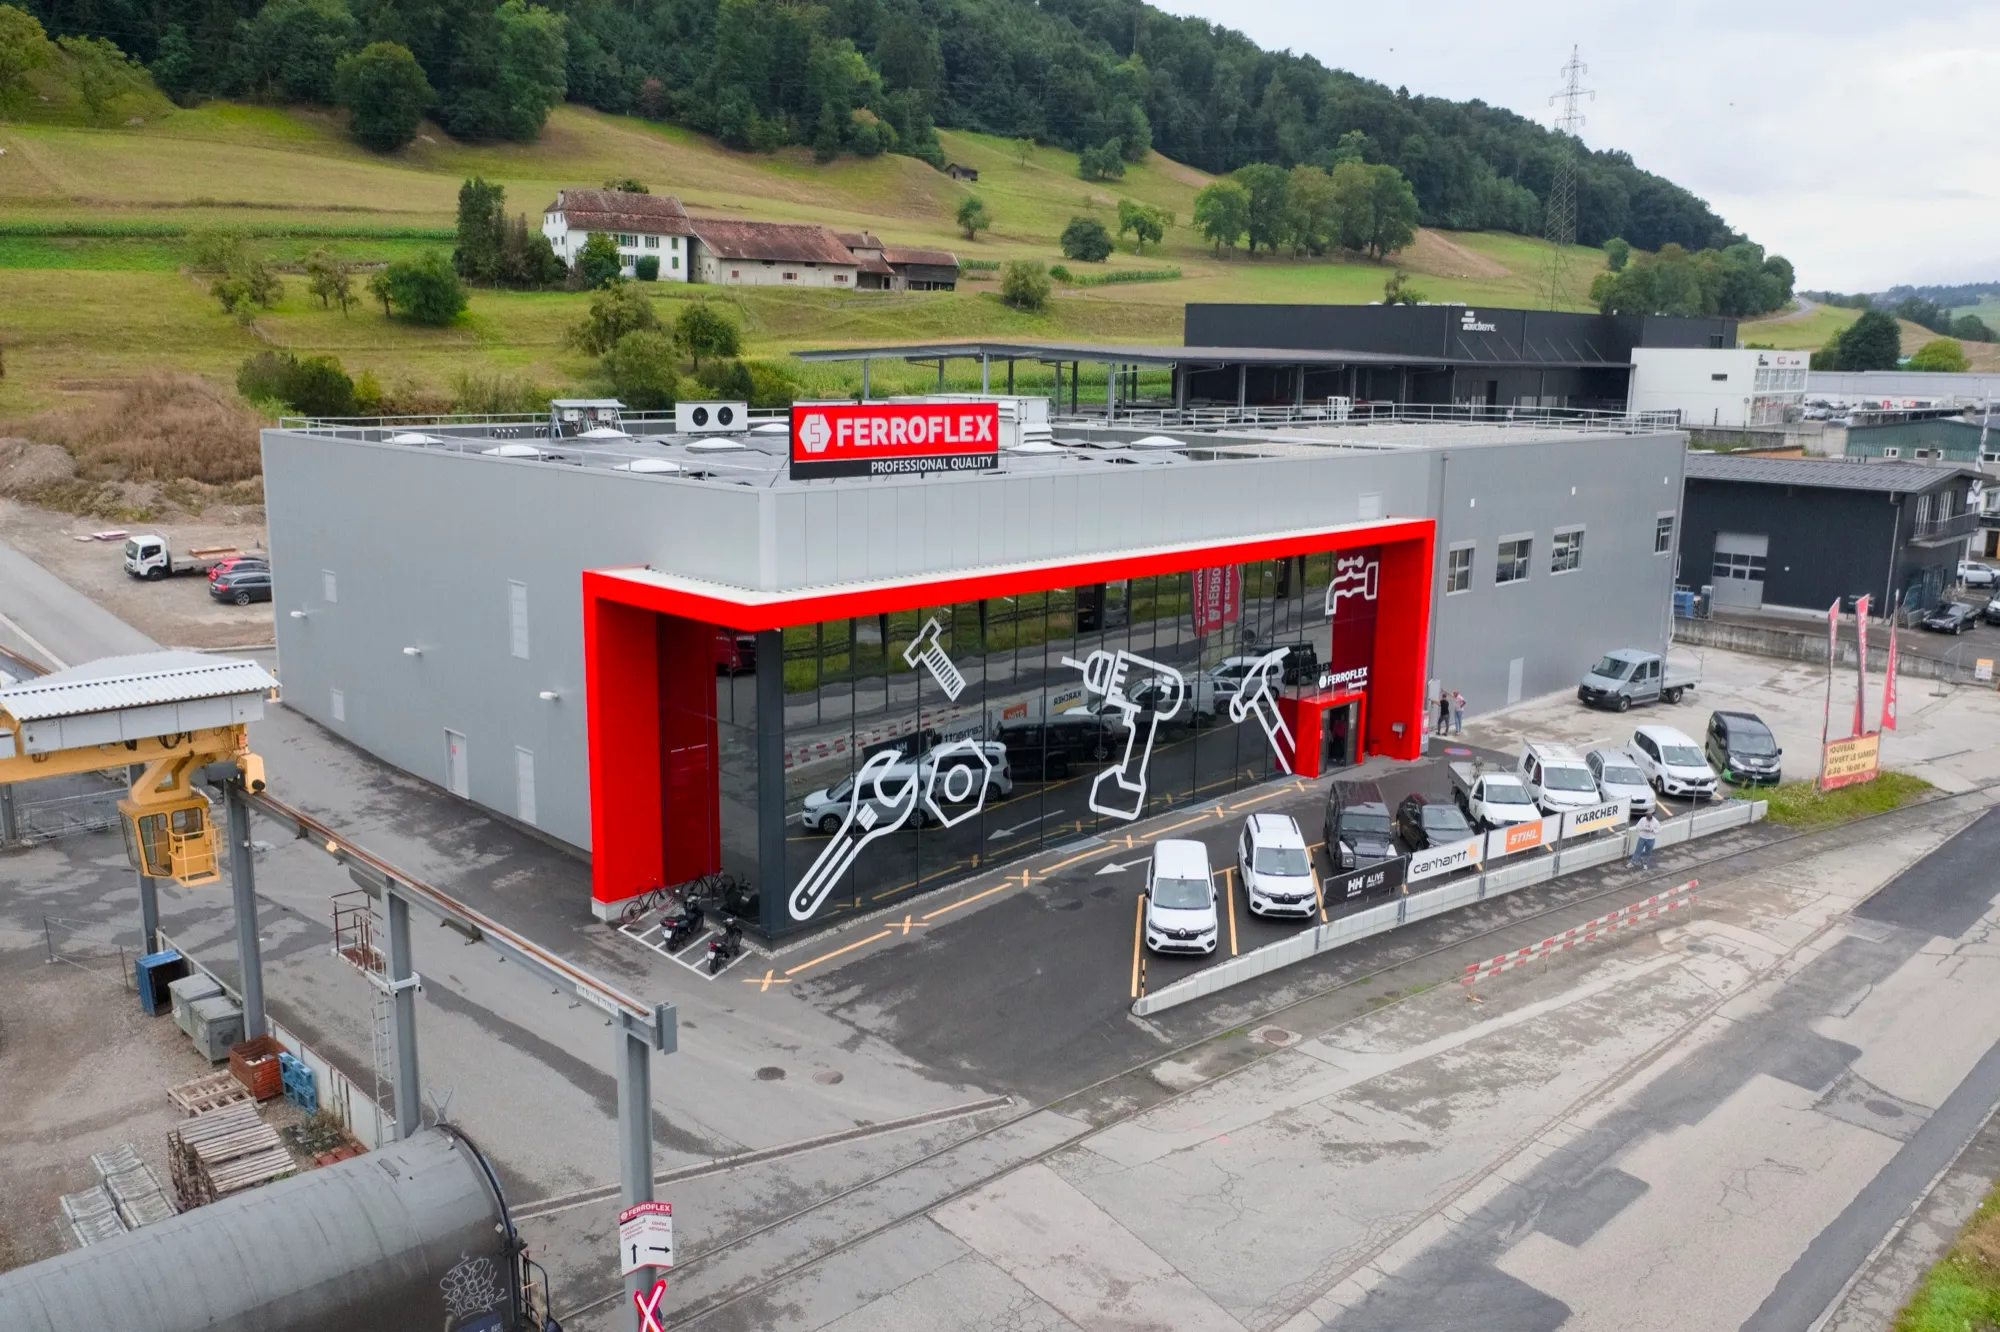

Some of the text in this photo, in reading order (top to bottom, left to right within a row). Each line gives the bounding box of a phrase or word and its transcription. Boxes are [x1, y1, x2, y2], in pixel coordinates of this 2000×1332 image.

[836, 415, 993, 447] FERROFLEX
[871, 456, 993, 473] PROFESSIONAL QUALITY
[1327, 667, 1368, 686] FERROFLEX
[1575, 804, 1619, 825] KÄRCHER
[1509, 828, 1538, 845] STIHL
[1413, 849, 1467, 875] carhartt
[1347, 876, 1363, 892] HH
[1367, 871, 1385, 884] ALIVE
[628, 1204, 670, 1217] FERROFLEX
